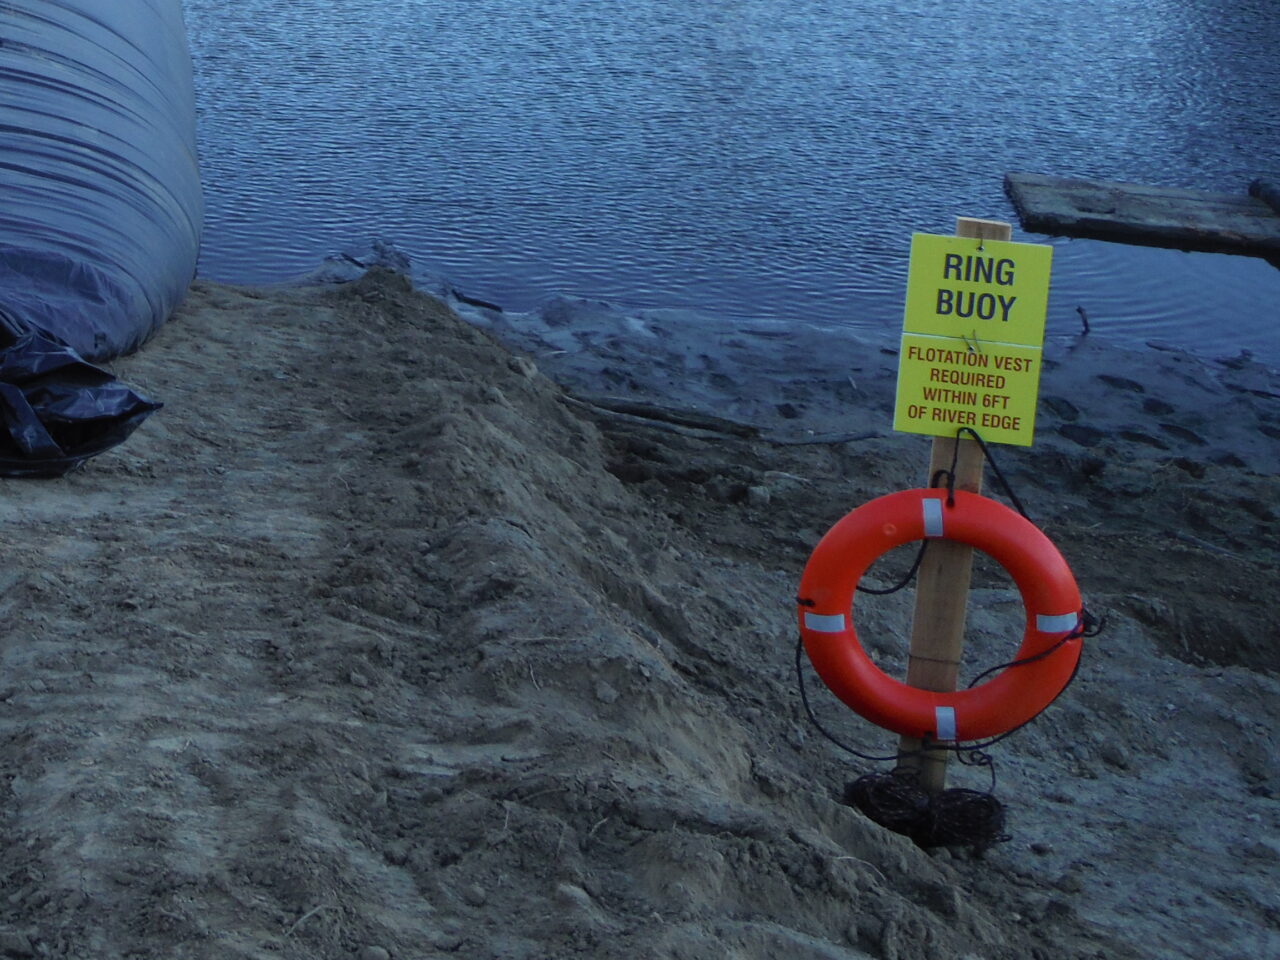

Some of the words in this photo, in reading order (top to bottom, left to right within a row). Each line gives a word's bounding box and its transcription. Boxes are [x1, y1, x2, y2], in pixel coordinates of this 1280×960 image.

[943, 253, 1015, 286] RING
[936, 288, 1017, 322] BUOY
[908, 346, 989, 368] FLOTATION
[994, 356, 1032, 373] VEST
[930, 368, 1006, 389] REQUIRED
[923, 387, 977, 406] WITHIN
[982, 394, 1010, 409] 6FT
[908, 405, 927, 419] OF
[932, 407, 976, 425] RIVER
[982, 413, 1021, 431] EDGE
